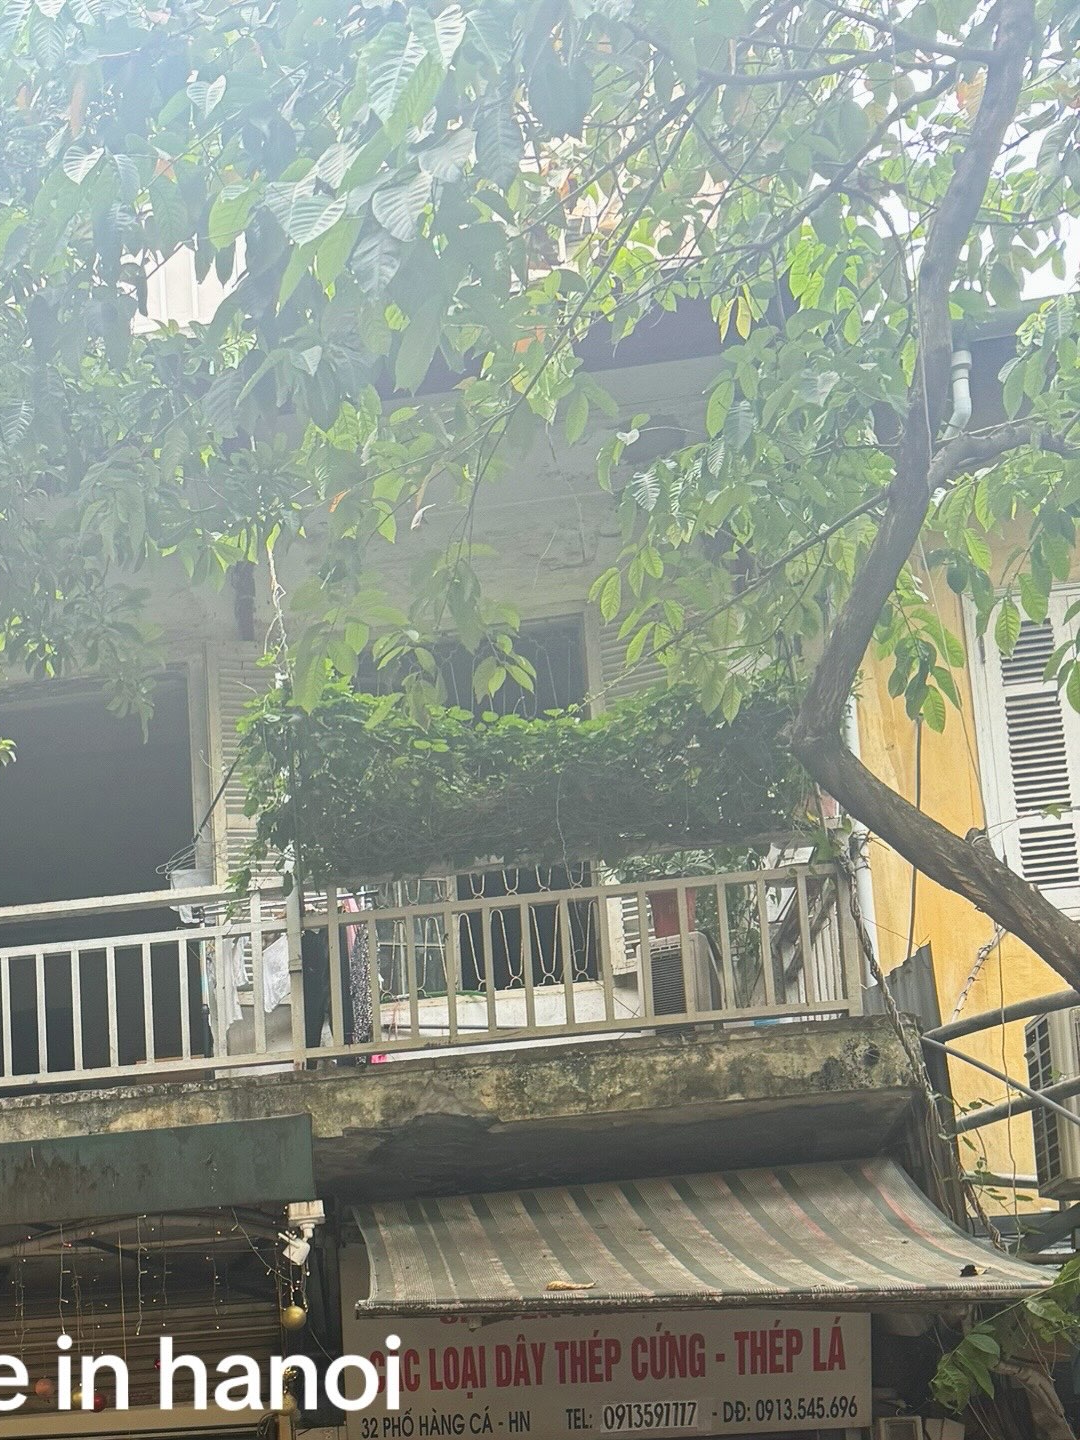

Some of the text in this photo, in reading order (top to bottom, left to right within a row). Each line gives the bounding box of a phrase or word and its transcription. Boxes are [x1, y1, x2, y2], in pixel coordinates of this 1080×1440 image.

[429, 1346, 486, 1399] LOẠI
[495, 1334, 546, 1388] DÂY
[554, 1330, 621, 1385] THÉP
[631, 1322, 706, 1381] CỨNG
[734, 1320, 803, 1376] THÉP
[813, 1316, 846, 1372] LÁ
[361, 1417, 378, 1439] 32
[383, 1407, 414, 1438] PHỐ
[419, 1408, 465, 1436] HÀNG
[470, 1406, 493, 1434] CÁ
[509, 1411, 530, 1433] HN
[566, 1407, 593, 1430] TEL:
[604, 1402, 697, 1430] 0913591117
[723, 1400, 751, 1423] DĐ:
[756, 1396, 857, 1421] 0913.545.696
